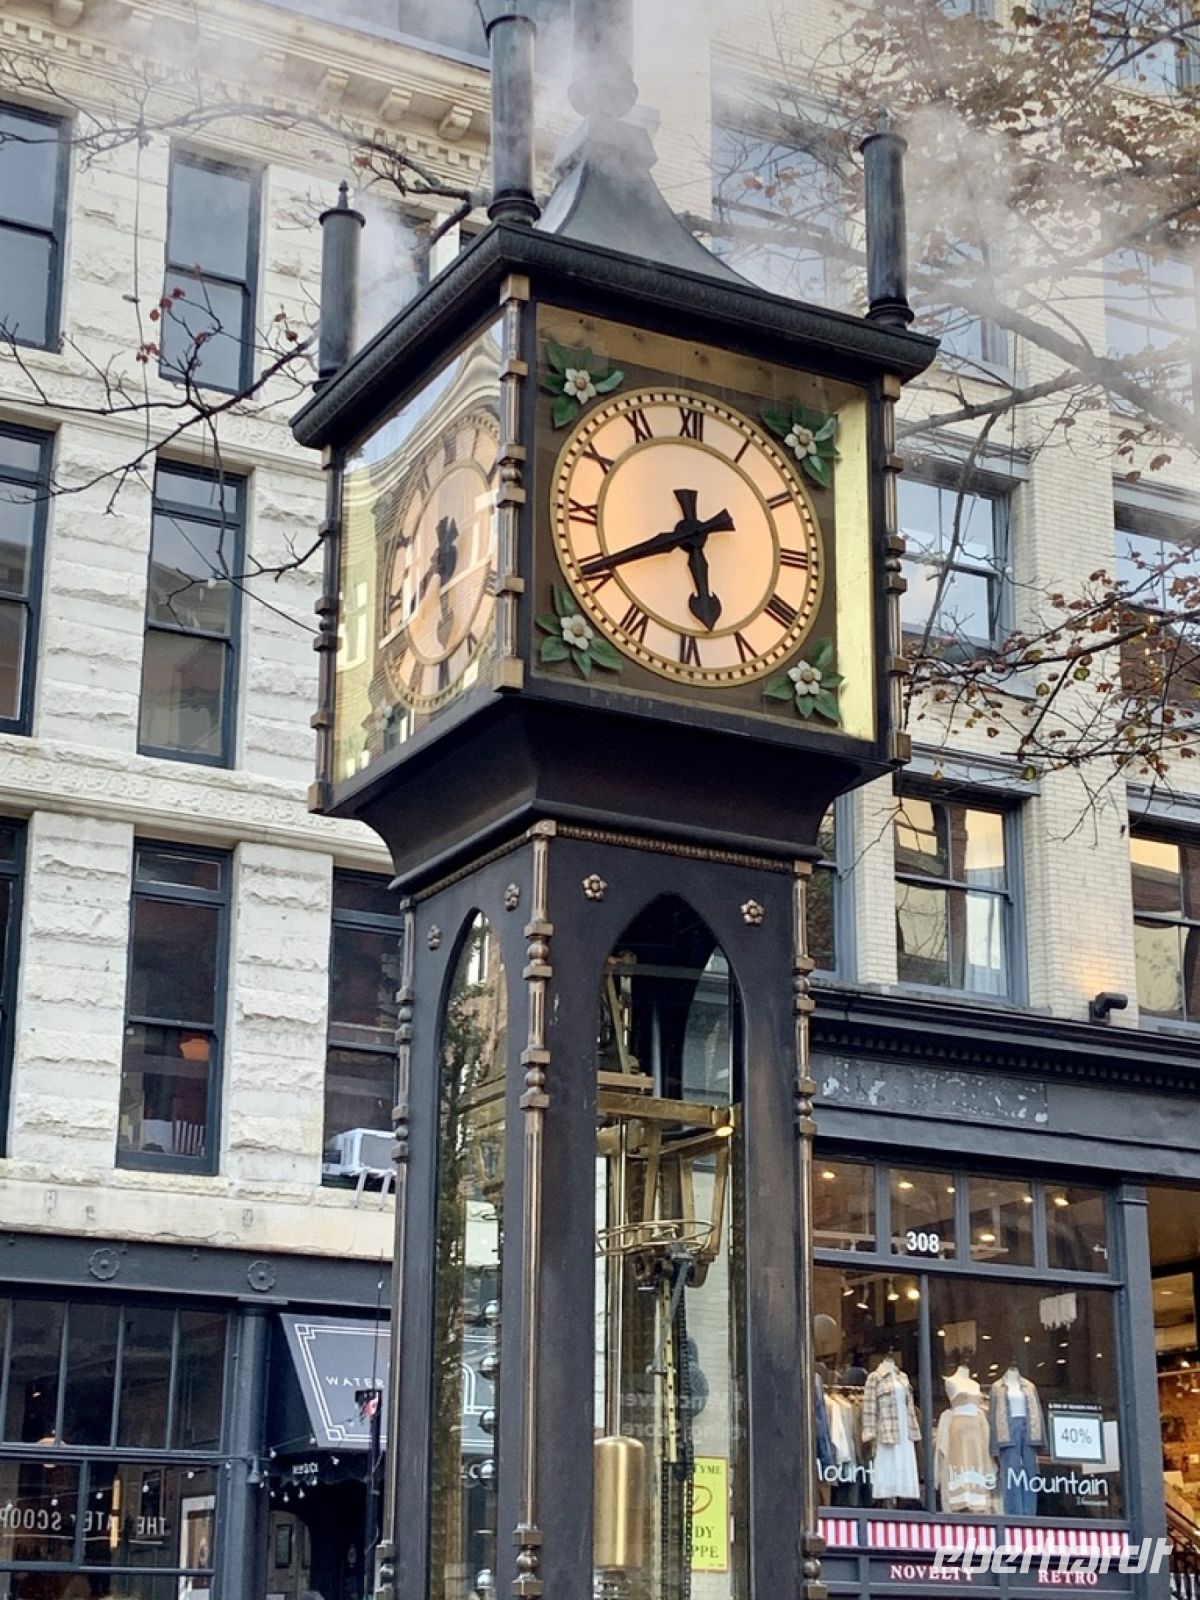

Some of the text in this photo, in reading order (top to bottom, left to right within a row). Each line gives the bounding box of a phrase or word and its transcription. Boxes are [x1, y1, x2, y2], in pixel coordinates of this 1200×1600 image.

[624, 408, 653, 444] XI
[678, 407, 704, 442] XII
[581, 442, 615, 475] X
[568, 498, 598, 525] IX
[906, 1230, 940, 1253] 308
[326, 1376, 385, 1388] WATER
[1060, 1427, 1092, 1444] 40%
[1006, 1467, 1109, 1496] Mountain
[889, 1565, 1099, 1585] NOVELTY RETRO
